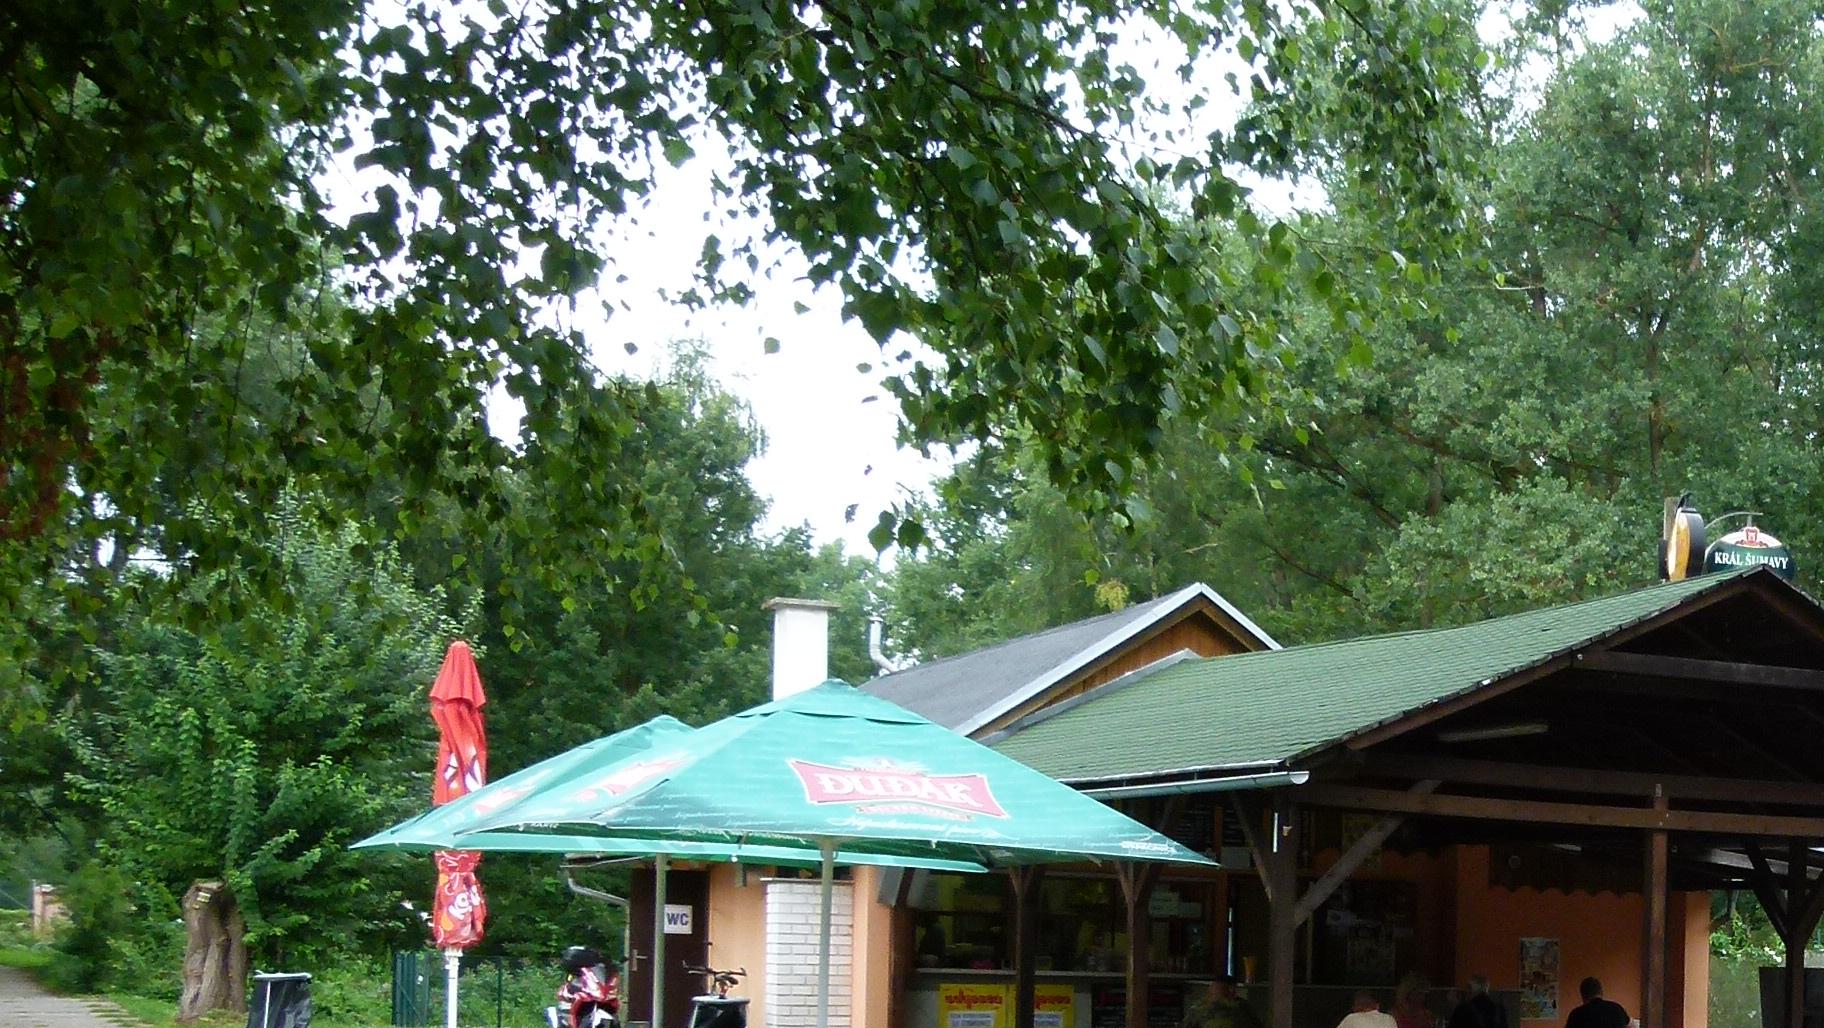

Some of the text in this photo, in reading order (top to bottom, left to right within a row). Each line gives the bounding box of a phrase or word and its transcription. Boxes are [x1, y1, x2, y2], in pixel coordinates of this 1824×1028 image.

[1714, 551, 1789, 570] KRÁL ŠUMAVY
[666, 912, 689, 926] WC
